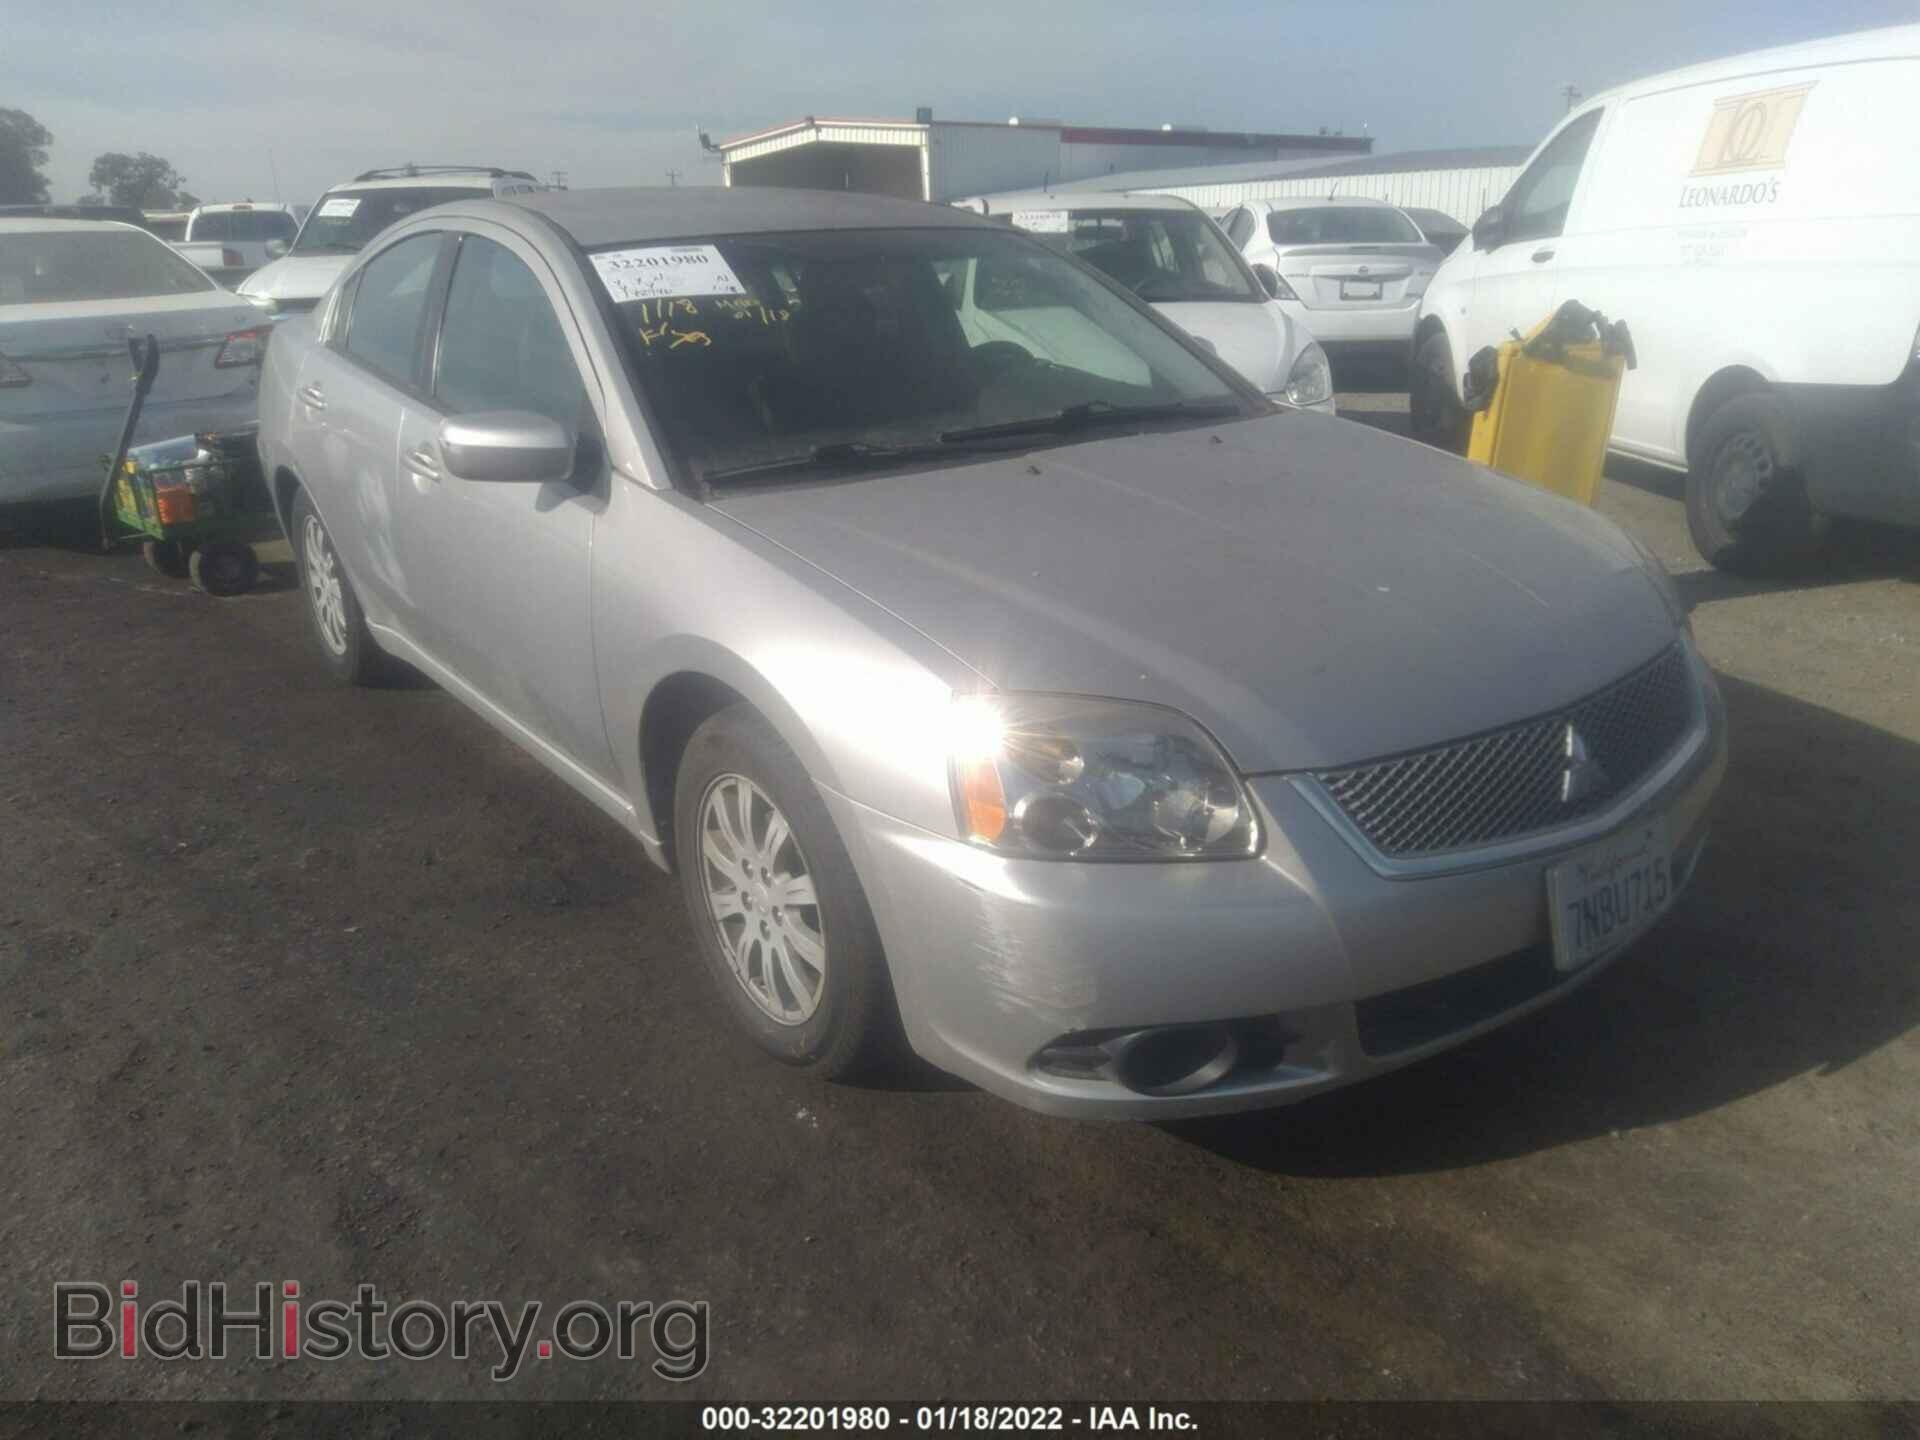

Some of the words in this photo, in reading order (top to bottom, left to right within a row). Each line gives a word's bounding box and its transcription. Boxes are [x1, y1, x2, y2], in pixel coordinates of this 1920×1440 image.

[1679, 178, 1780, 208] LEONARDO'S
[608, 254, 709, 270] 32201980
[1567, 857, 1667, 947] 7NBU715
